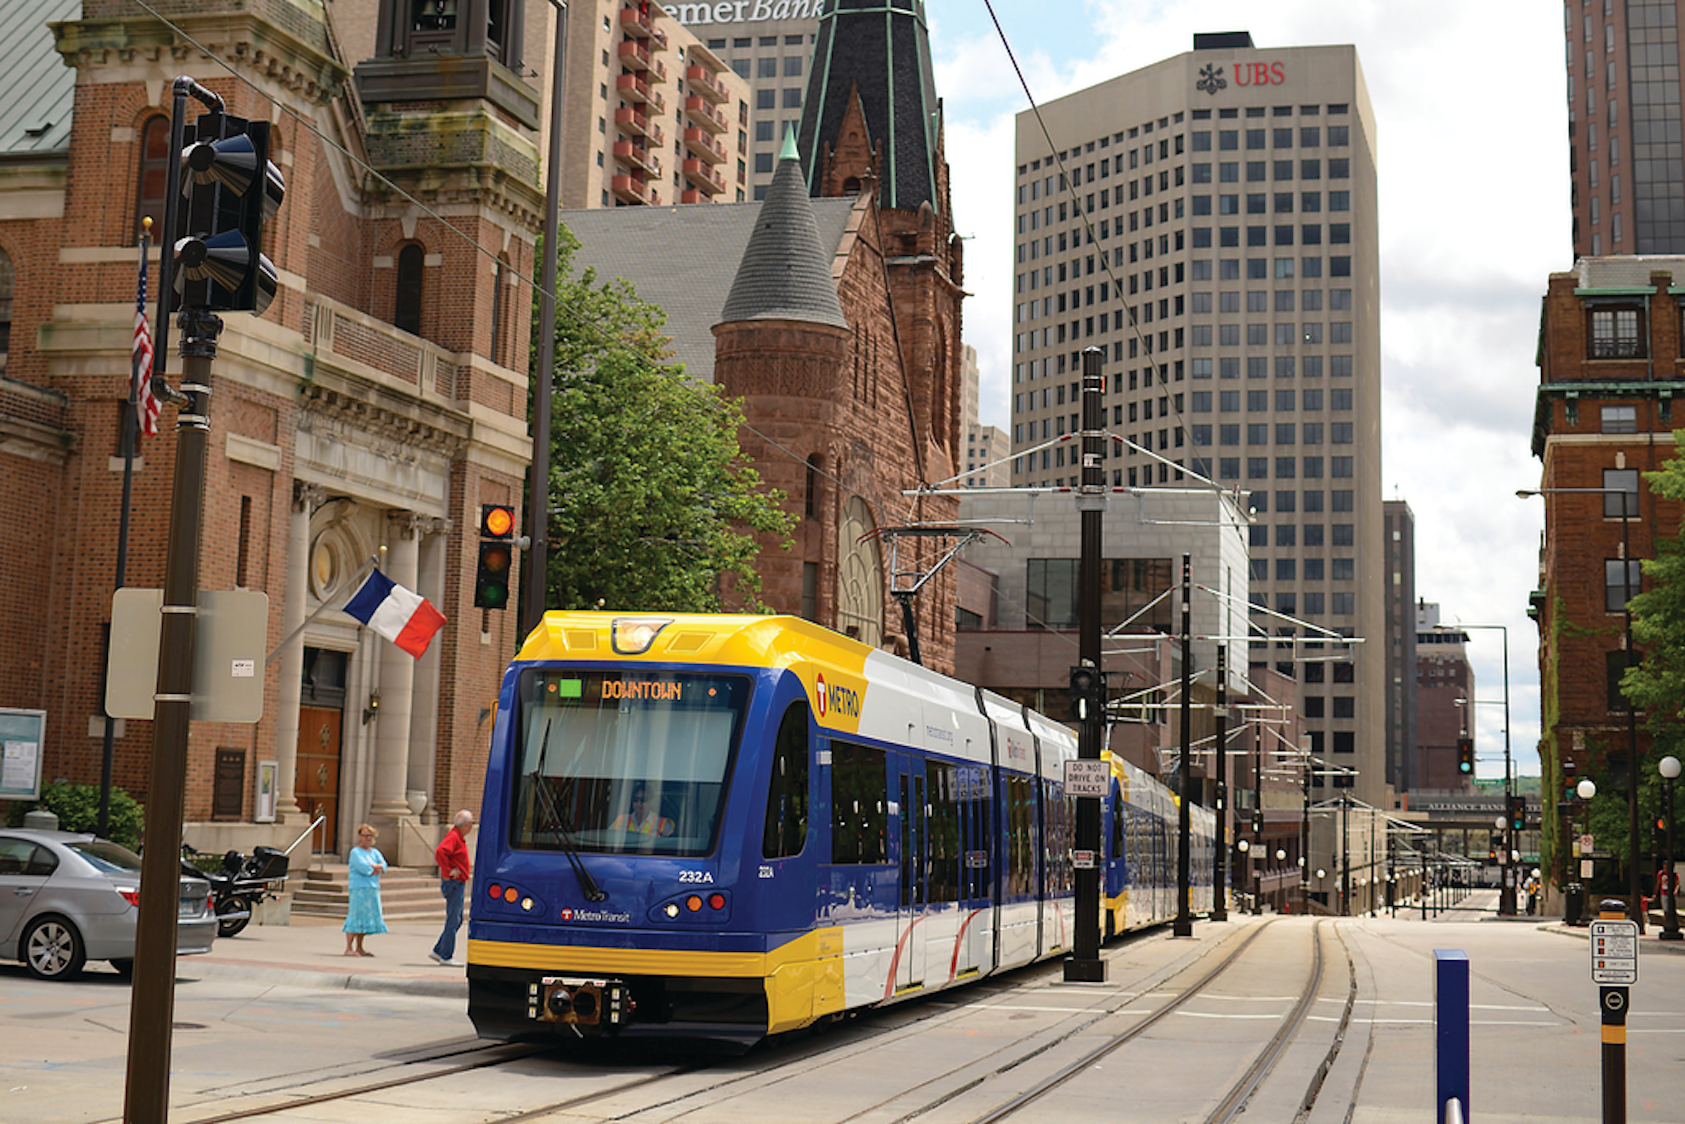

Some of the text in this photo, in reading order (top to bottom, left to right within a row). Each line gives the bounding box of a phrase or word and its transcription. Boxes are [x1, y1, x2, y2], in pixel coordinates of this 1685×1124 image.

[1233, 61, 1285, 86] UBS
[601, 680, 682, 701] DOWNTOWN
[828, 683, 860, 718] METRO
[1073, 763, 1083, 771] DO
[1069, 774, 1106, 782] DRIVE ON
[1073, 784, 1101, 793] TRACKS
[1429, 802, 1477, 811] ALLIANCE
[679, 870, 714, 883] 232A
